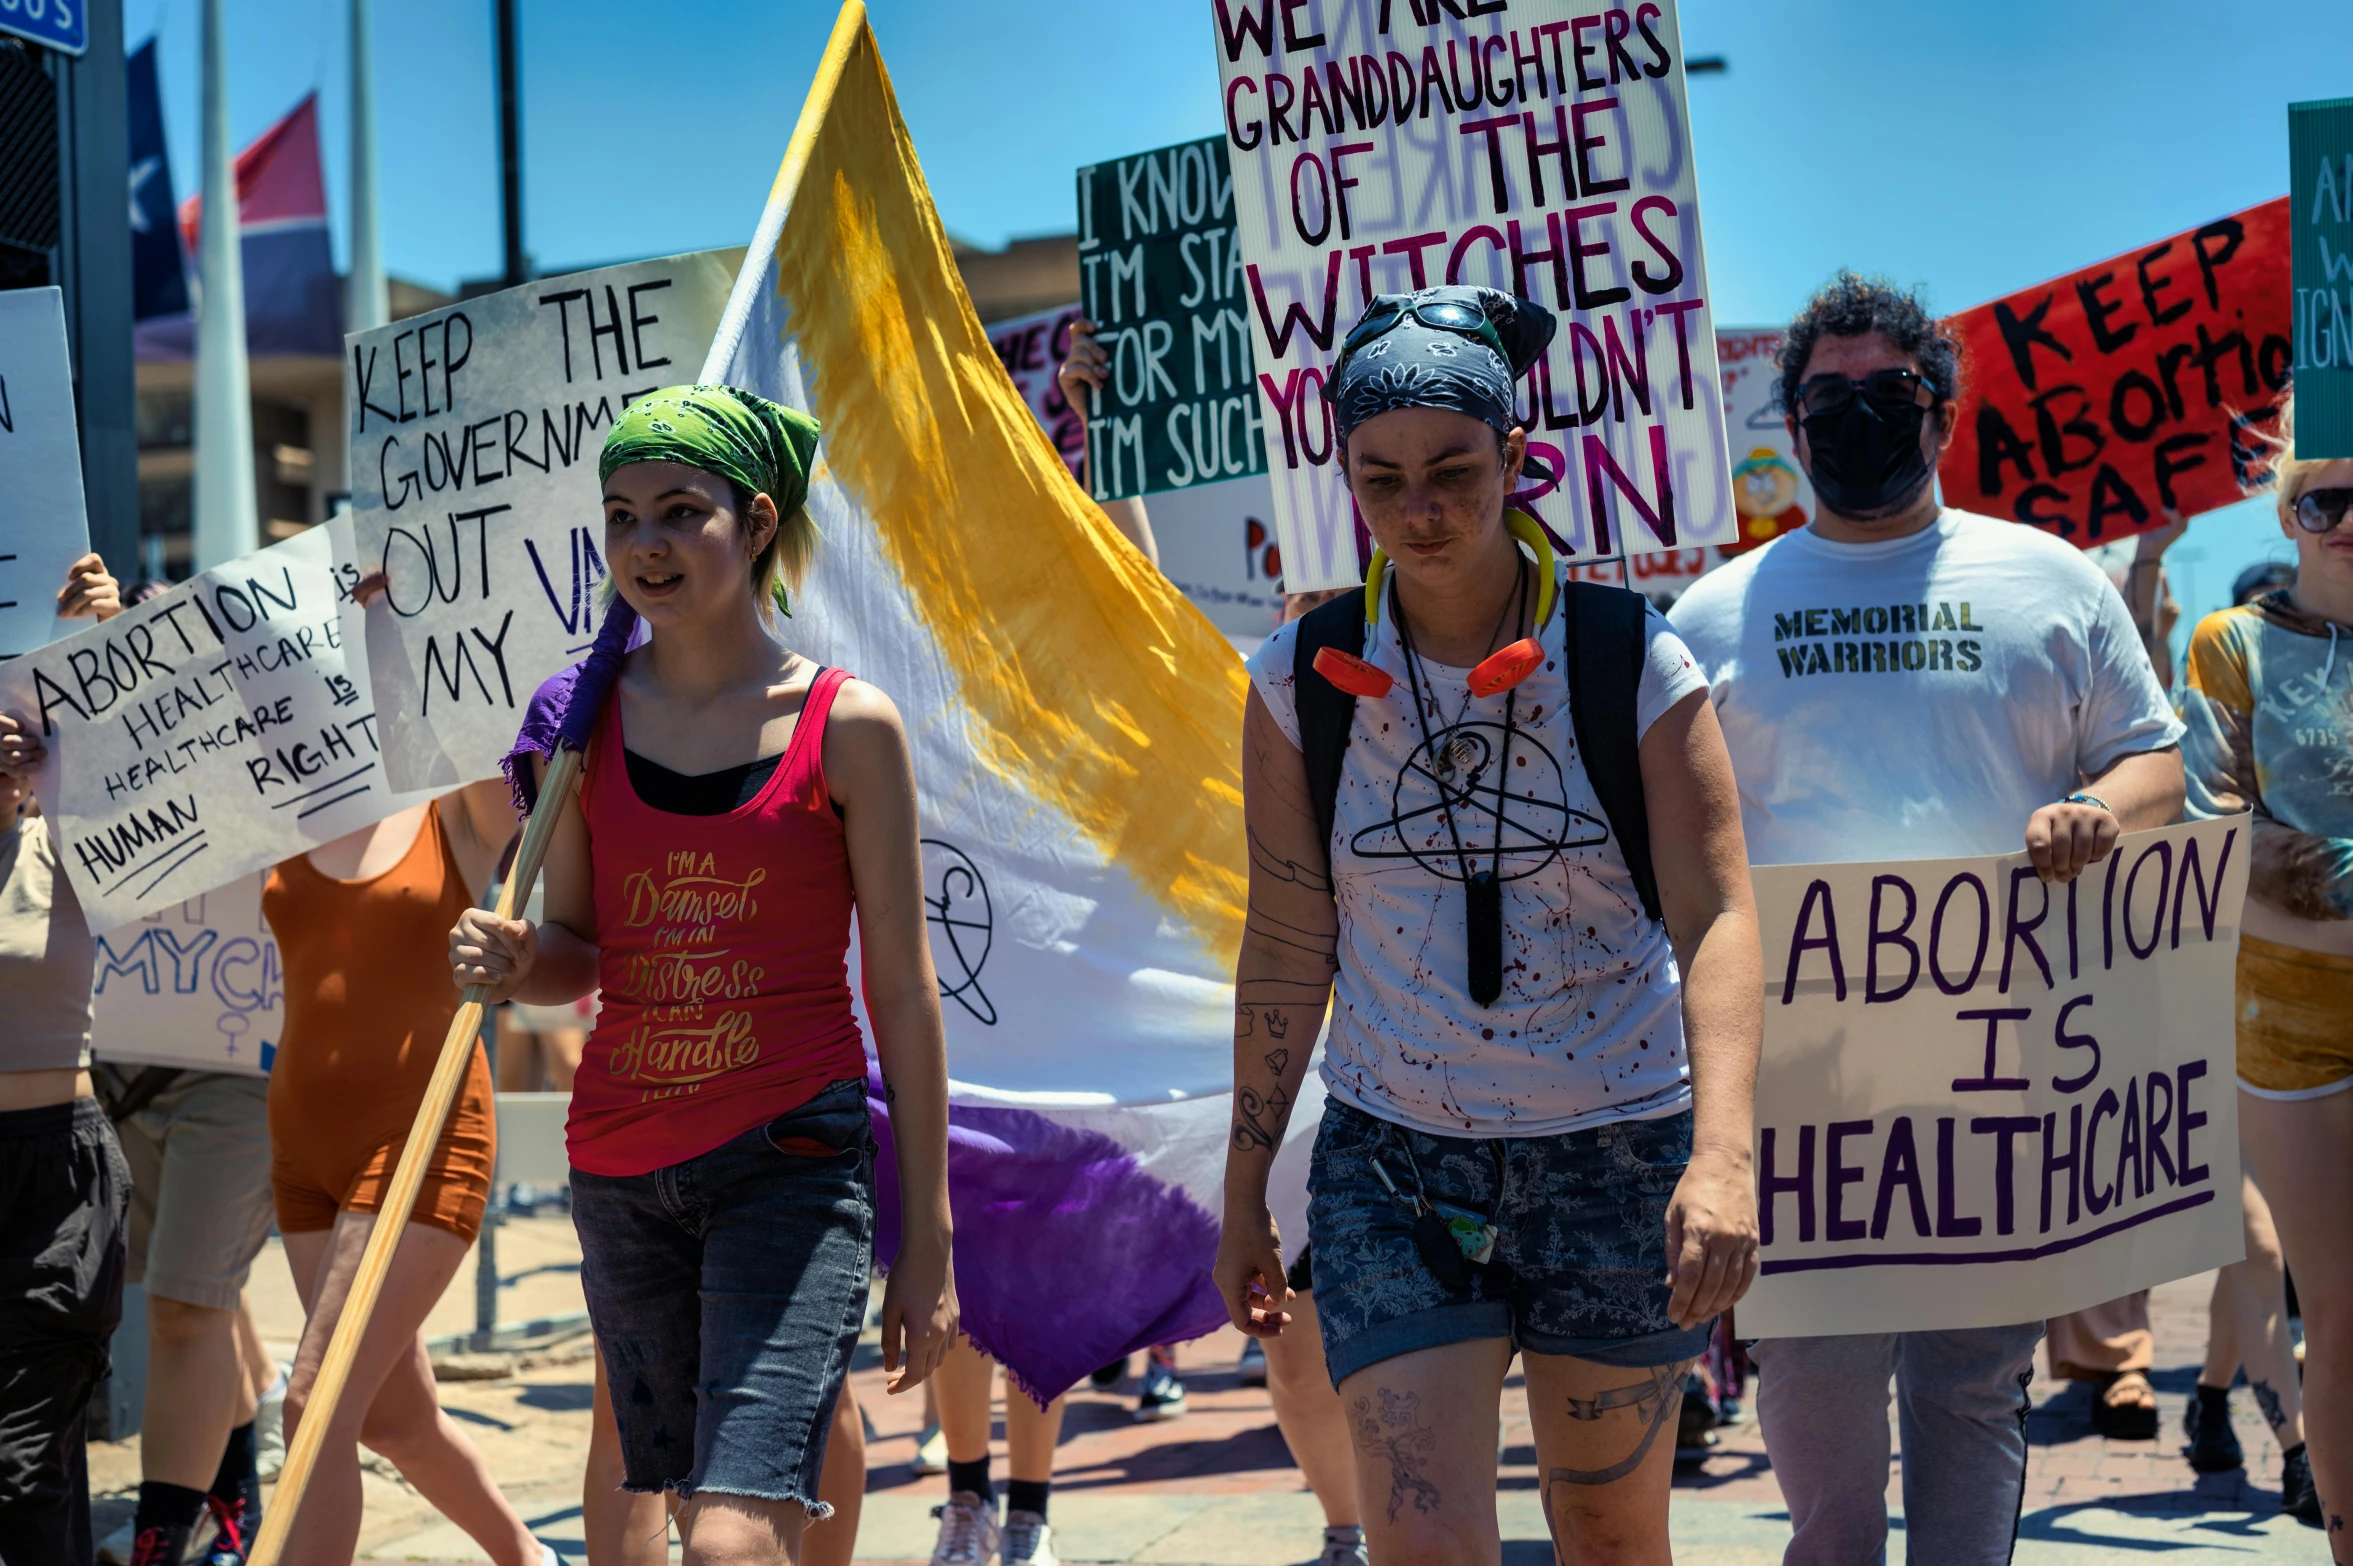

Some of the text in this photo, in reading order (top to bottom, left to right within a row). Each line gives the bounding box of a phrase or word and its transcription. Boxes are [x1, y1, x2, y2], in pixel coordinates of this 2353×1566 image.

[1226, 2, 1672, 151] GRANDDAUGHTERS
[1079, 166, 1099, 250] I
[1290, 98, 1631, 246] OF THE
[1083, 243, 1147, 325] I'M
[1245, 195, 1684, 359] WITCHES
[1994, 217, 2245, 392] KEEP
[353, 279, 674, 434] KEEP THE
[1193, 308, 1252, 395] MY
[1089, 414, 1147, 501] I'M
[1167, 395, 1265, 487] SUCH
[1259, 364, 1344, 469] YO
[383, 505, 512, 617] OUT
[31, 565, 298, 737] ABORTION
[421, 609, 517, 718] MY
[1775, 602, 1984, 642] MEMORIAL
[1776, 639, 1983, 679] WARRIORS
[121, 615, 343, 751] HEALTHCARE
[74, 711, 381, 884] HUMAN RIGHT
[104, 695, 294, 801] HEALTHCARE
[667, 851, 716, 876] I'M A
[1782, 828, 2237, 1004] ABORTION
[653, 924, 716, 949] I'M IN
[609, 1009, 760, 1081] Handle
[1951, 995, 2101, 1093] IS
[1759, 1060, 2209, 1246] HEALTHCARE
